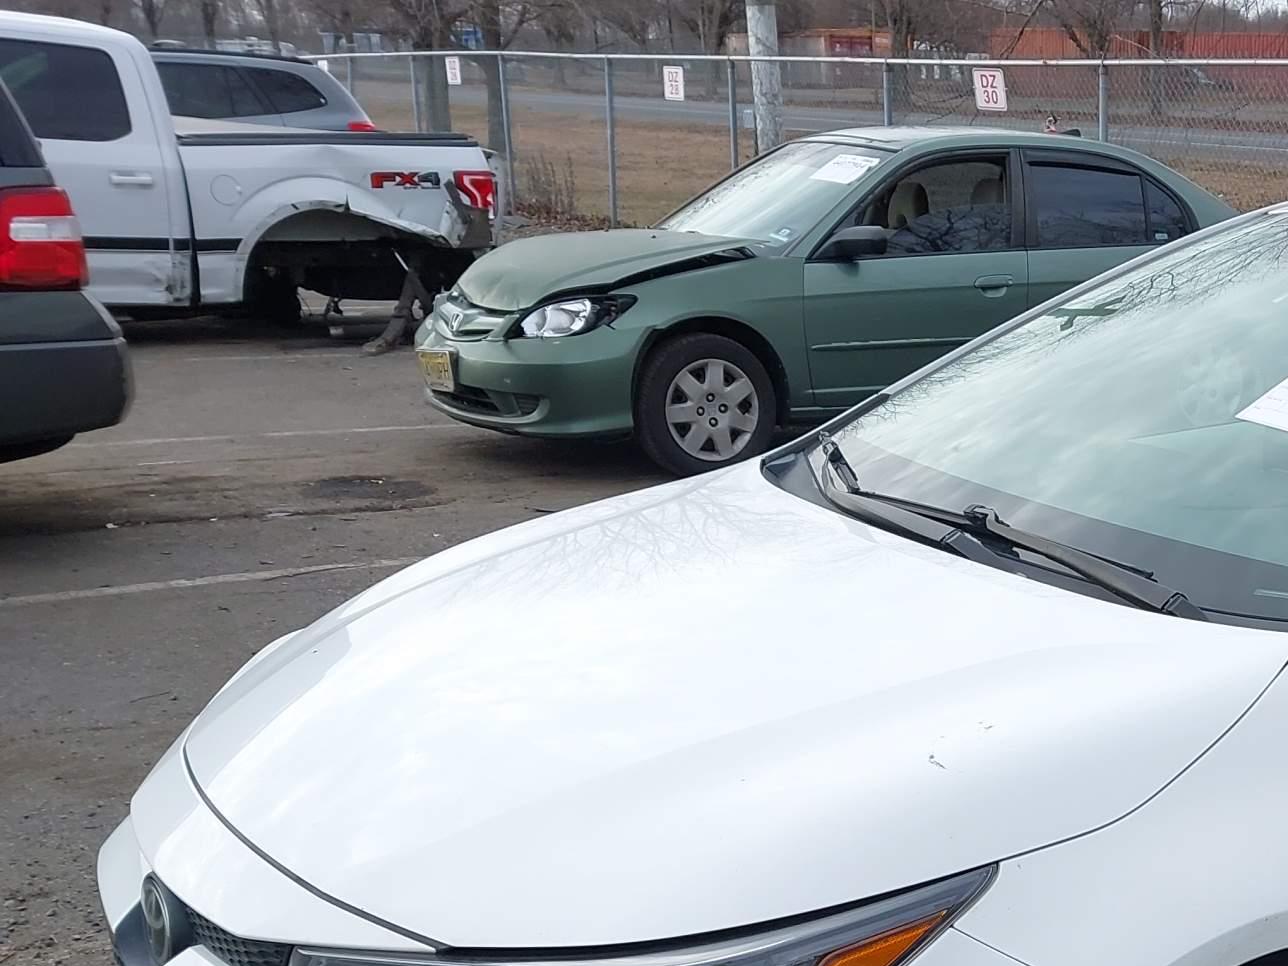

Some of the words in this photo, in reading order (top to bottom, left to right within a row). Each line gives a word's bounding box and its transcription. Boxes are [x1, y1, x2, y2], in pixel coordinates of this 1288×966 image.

[667, 71, 679, 83] DZ
[980, 74, 998, 88] DZ
[983, 90, 999, 104] 30
[370, 171, 441, 189] FX4
